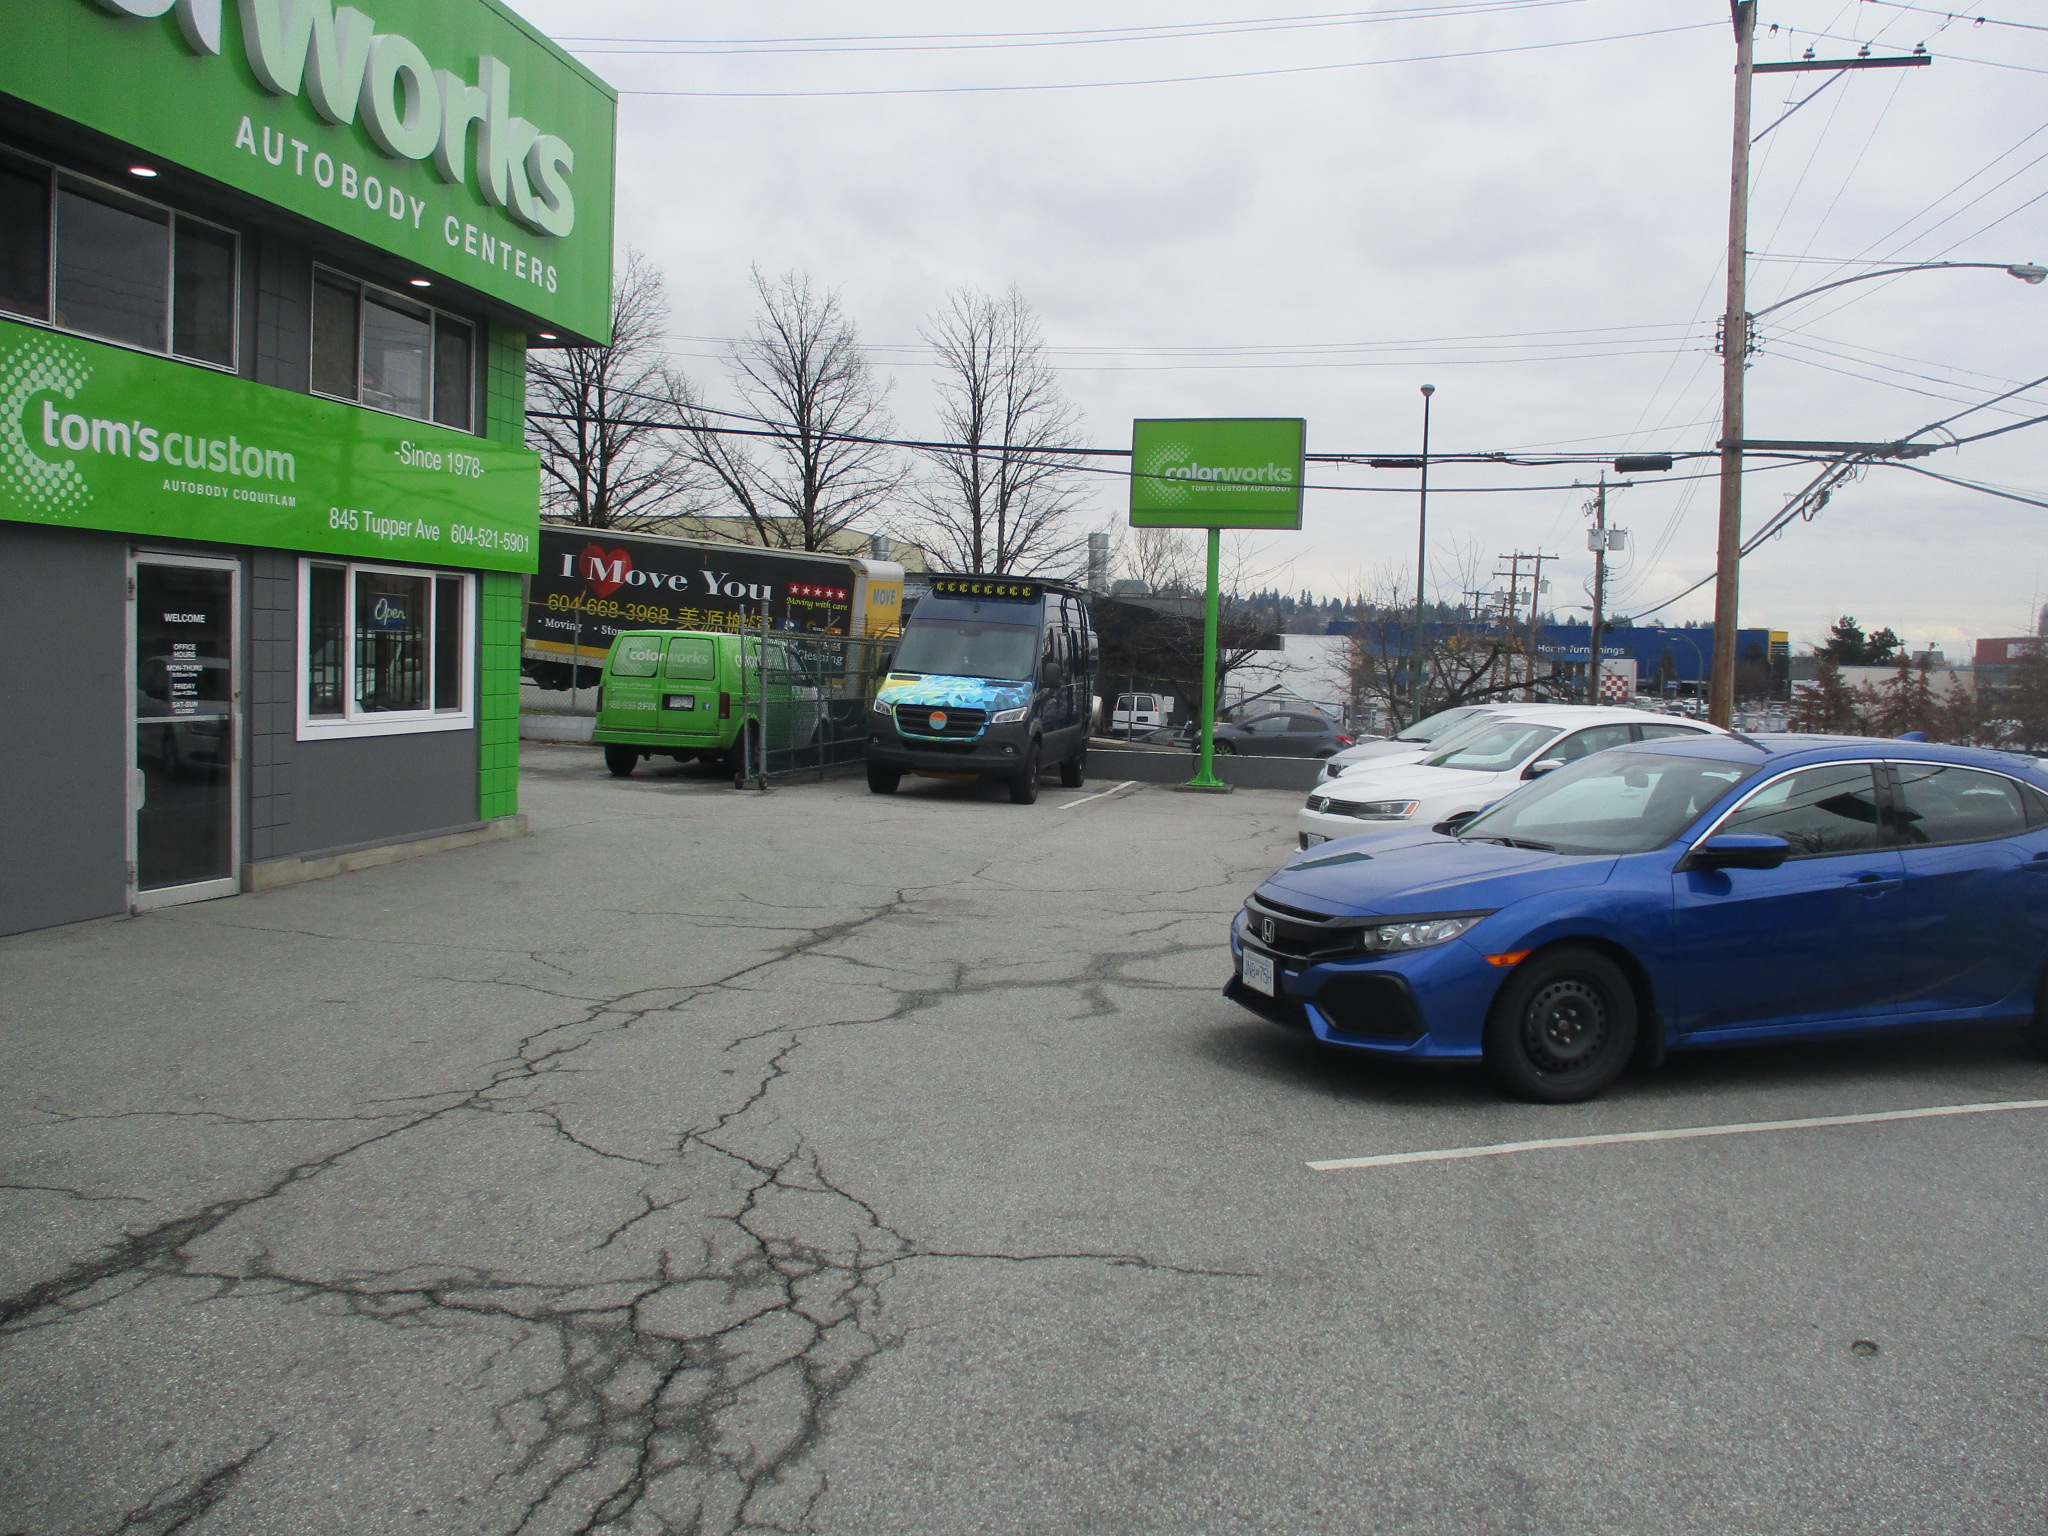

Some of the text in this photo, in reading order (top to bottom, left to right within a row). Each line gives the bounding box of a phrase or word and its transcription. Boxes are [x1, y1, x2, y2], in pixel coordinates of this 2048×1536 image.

[235, 116, 558, 294] AUTOBODY CENTERS
[1165, 463, 1292, 482] colorworks
[163, 479, 297, 508] AUTOBODY COQUITLAM
[329, 507, 529, 553] 845 Tupper Ave 604-521-5901
[560, 553, 774, 602] I Move You
[786, 596, 848, 611] Moving with care
[873, 589, 896, 606] MOVE
[163, 613, 206, 623] WELCOME
[374, 598, 406, 626] Open
[548, 593, 669, 625] 604-668-3968
[545, 617, 582, 633] Moving
[173, 643, 197, 651] OFFICE
[629, 649, 709, 665] colorworks
